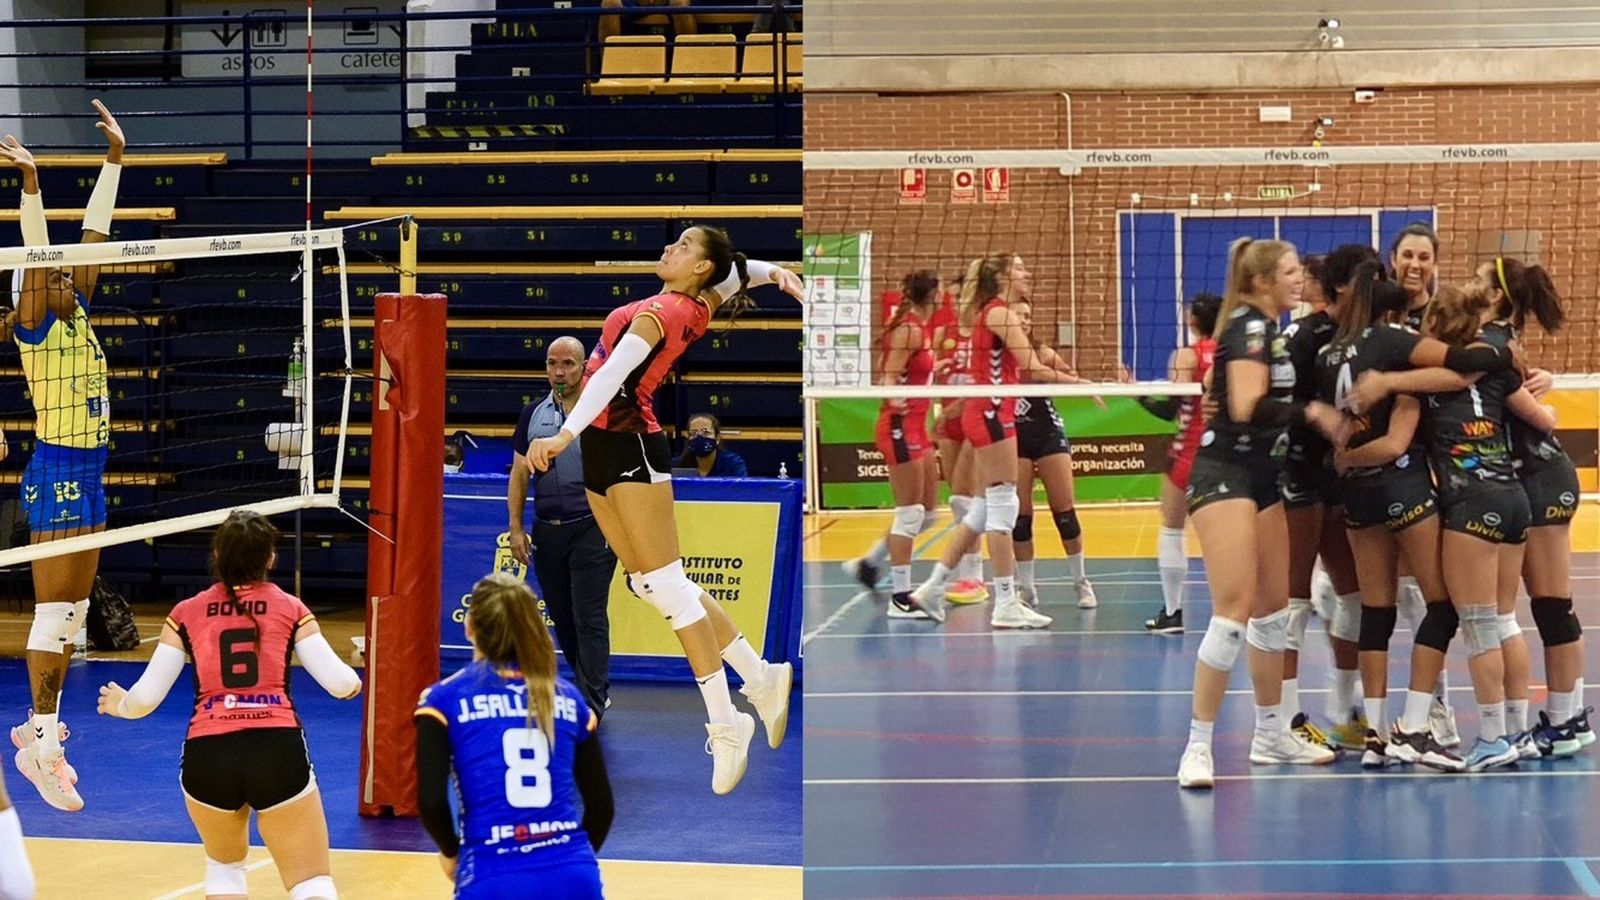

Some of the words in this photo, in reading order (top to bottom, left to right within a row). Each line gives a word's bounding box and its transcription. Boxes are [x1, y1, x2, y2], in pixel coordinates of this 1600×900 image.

[908, 153, 974, 165] rfevb.com
[1086, 152, 1152, 163] rfevb.com
[1264, 149, 1330, 161] rfevb.com
[1441, 147, 1508, 159] rfevb.com
[1101, 442, 1144, 453] necesita
[1071, 457, 1145, 472] organización
[219, 627, 260, 689] 6
[502, 727, 553, 808] 8
